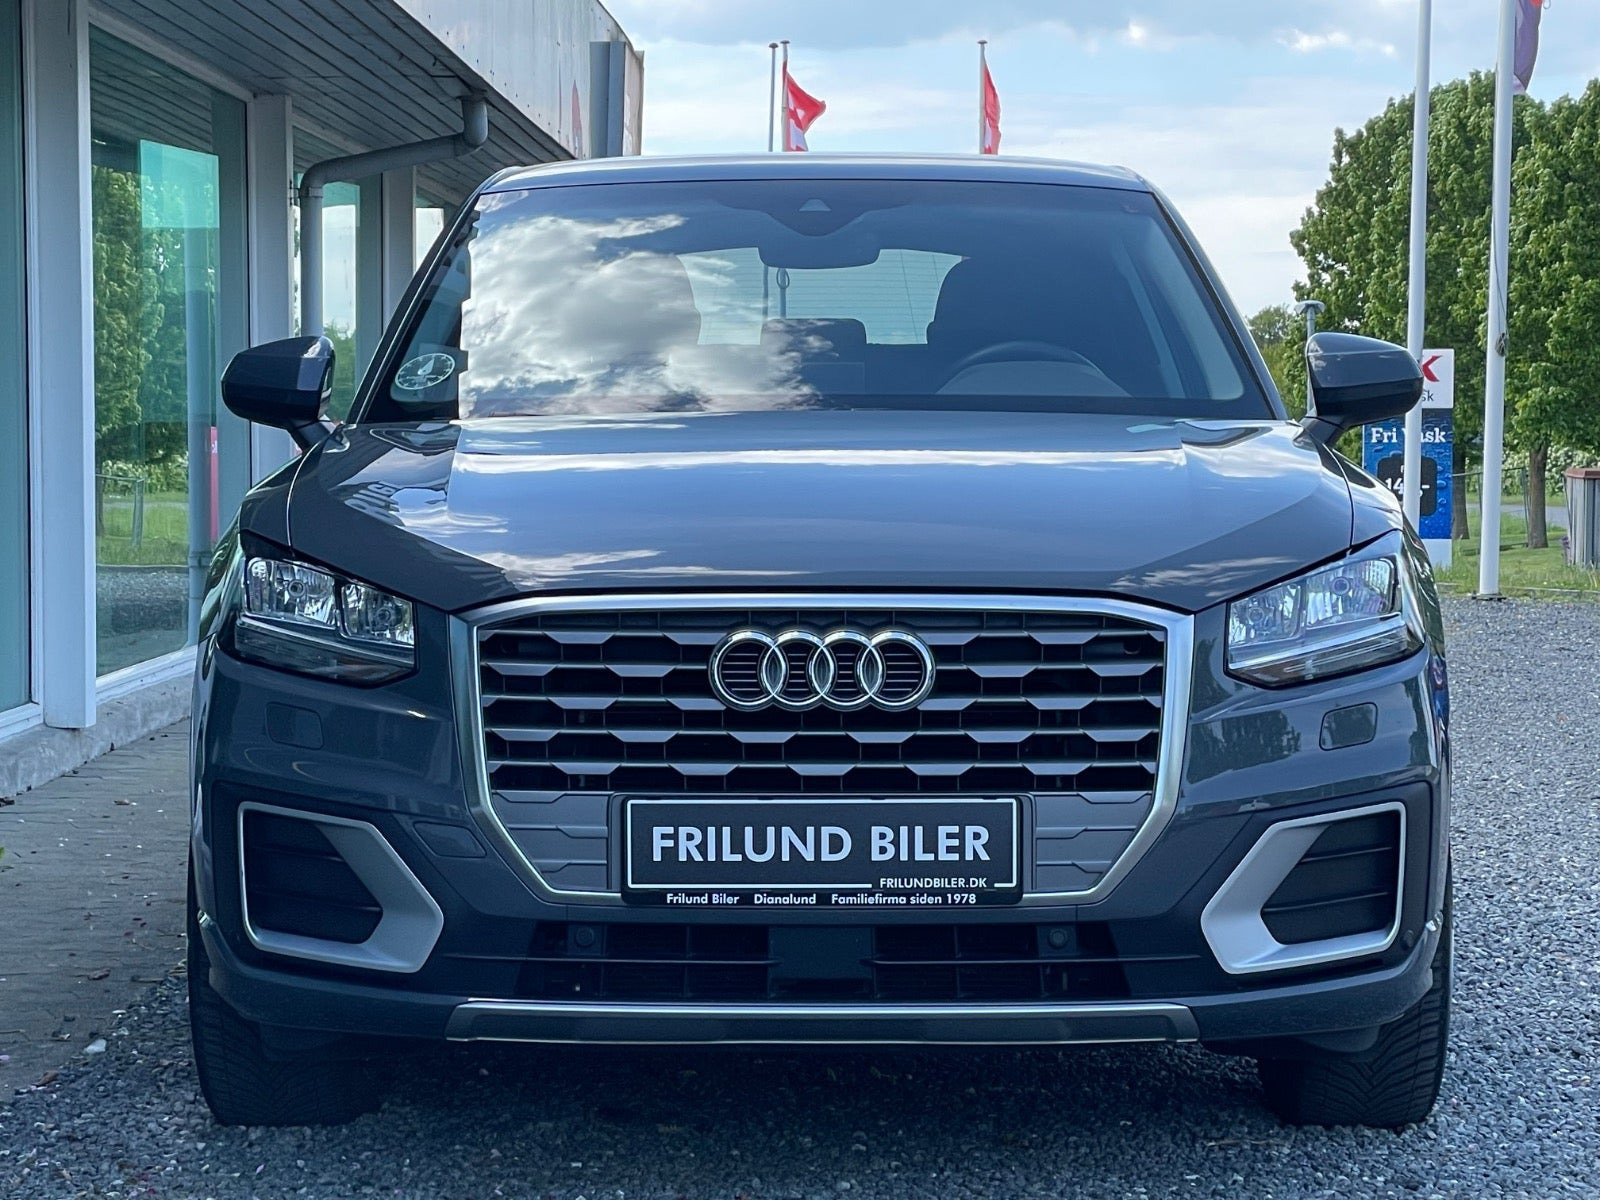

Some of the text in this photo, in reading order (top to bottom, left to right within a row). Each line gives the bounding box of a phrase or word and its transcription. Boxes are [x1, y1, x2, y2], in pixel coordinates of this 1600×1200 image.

[1371, 427, 1447, 443] Fri sk
[653, 826, 990, 862] FRILUND BILER
[880, 878, 986, 888] FRILUNDBILER.DK
[667, 893, 976, 904] Frilund Biler Dianalund Familiefirma siden 1978
